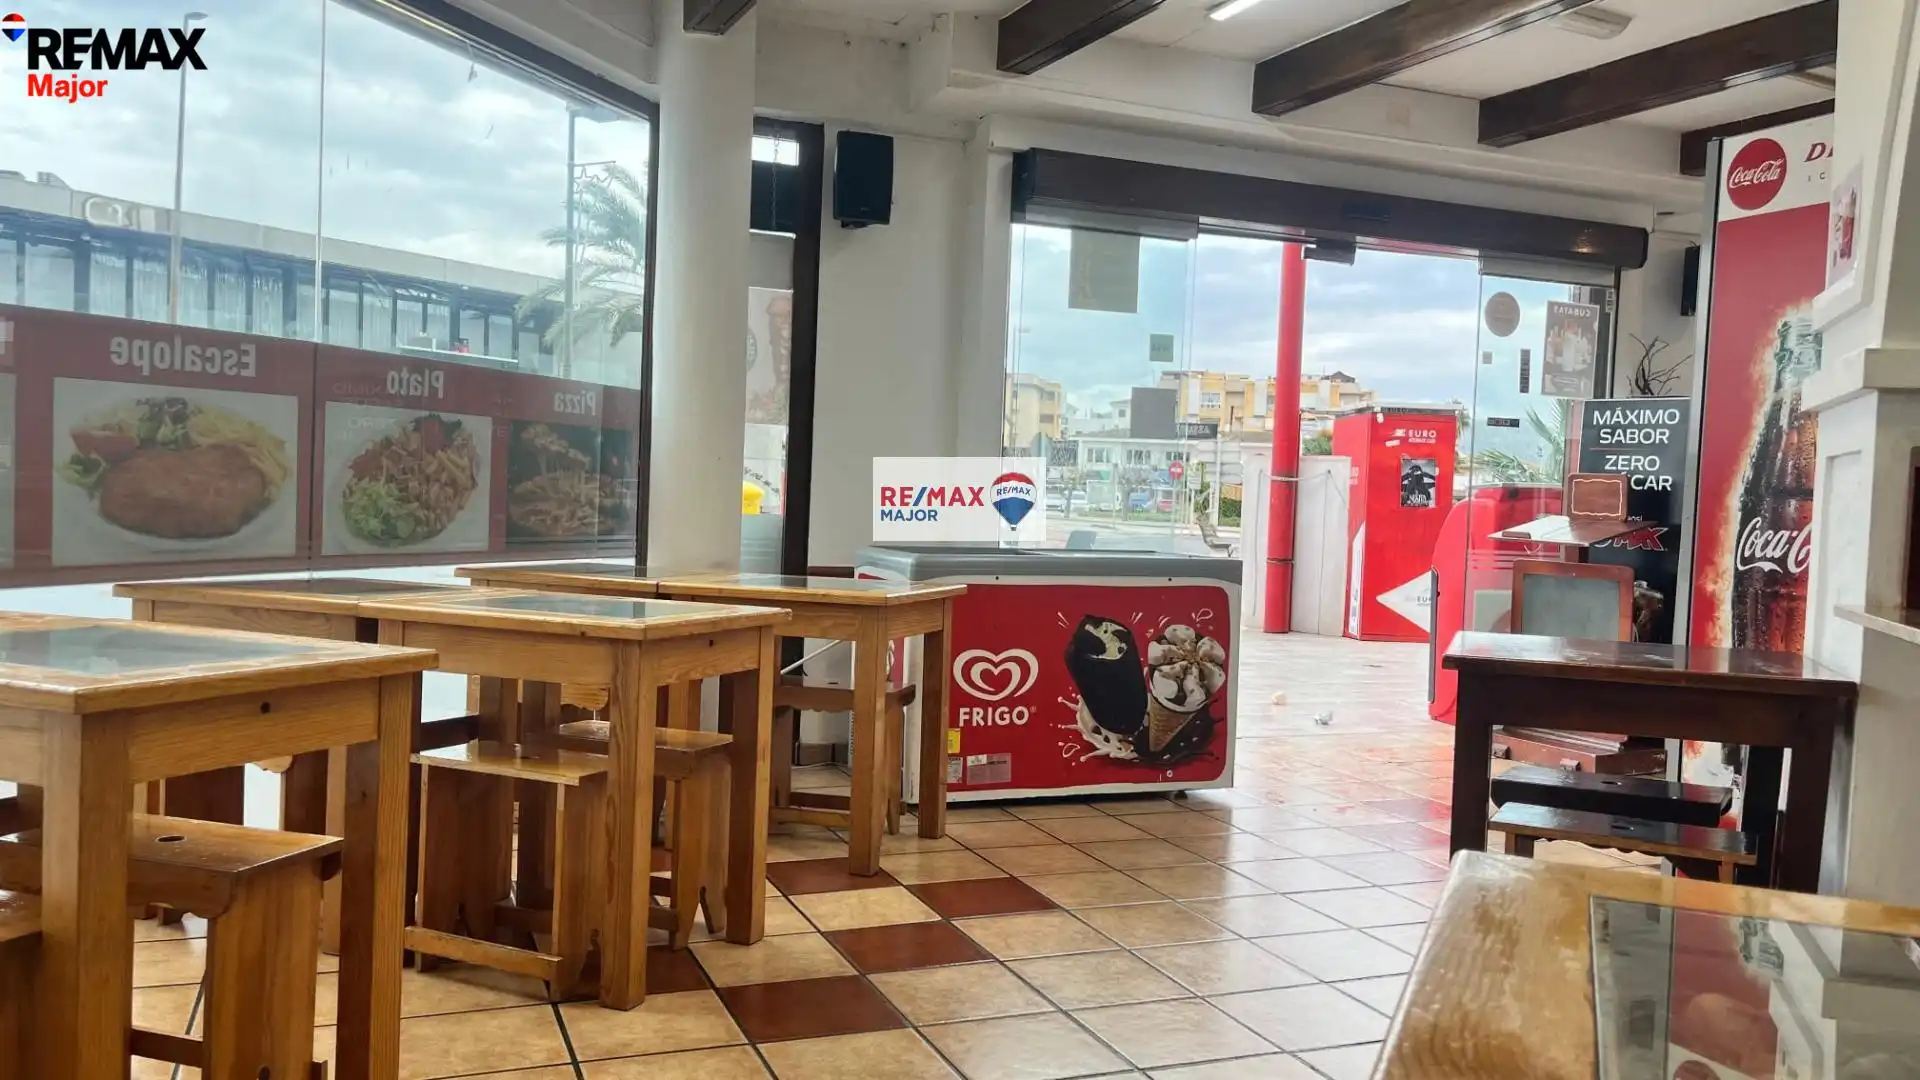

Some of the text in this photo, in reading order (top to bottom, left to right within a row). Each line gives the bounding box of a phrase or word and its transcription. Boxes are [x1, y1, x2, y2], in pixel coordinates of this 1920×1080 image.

[1592, 407, 1680, 425] MÁXIMO
[1408, 430, 1437, 438] EURO
[1599, 428, 1670, 444] SABOR
[1604, 455, 1660, 471] ZERO
[959, 706, 1030, 727] FRIGO
